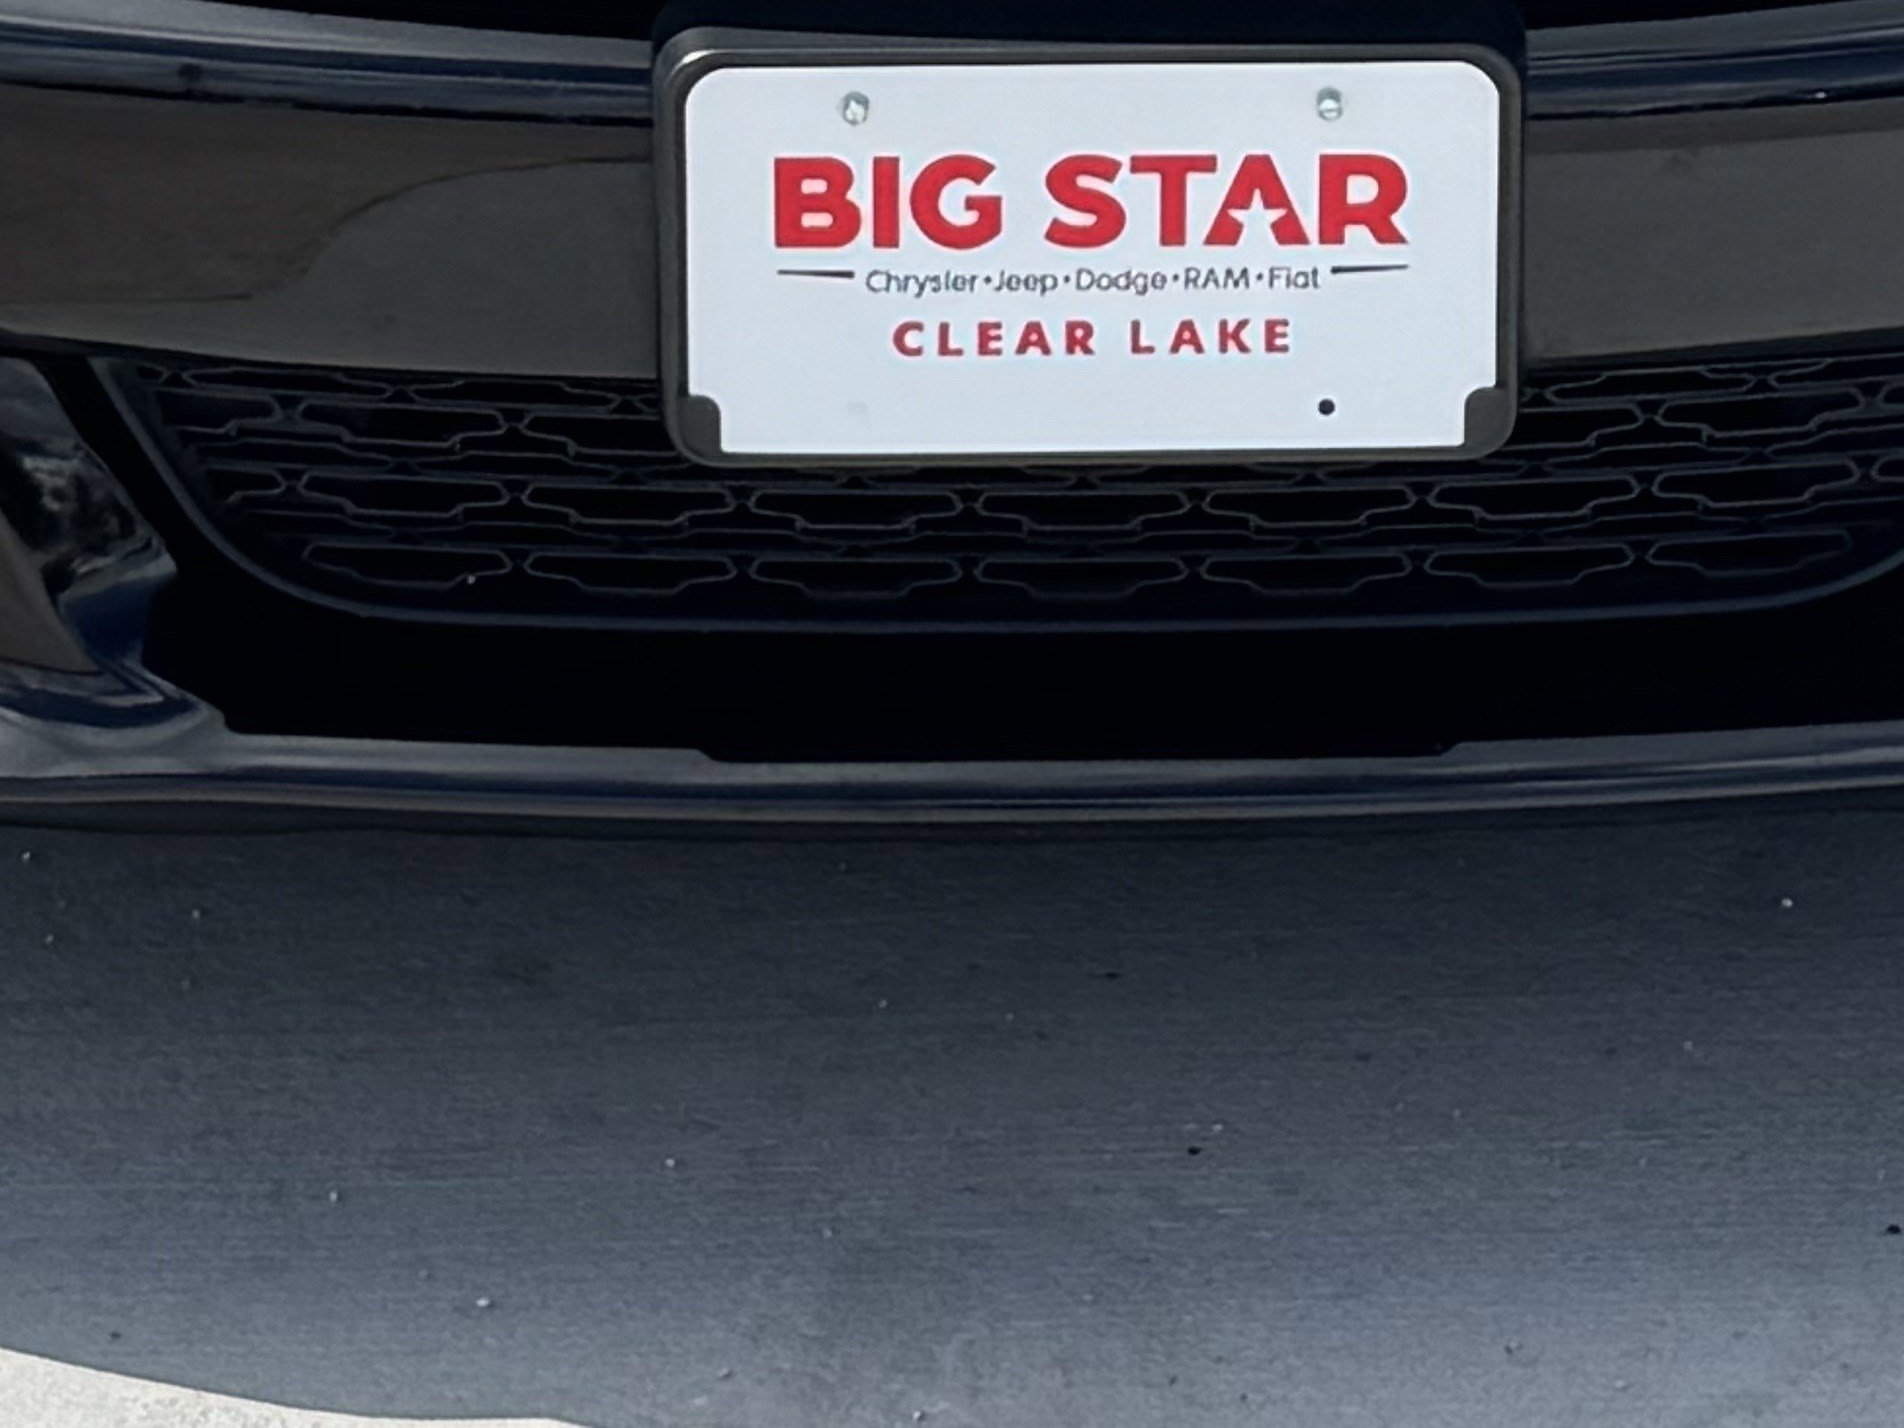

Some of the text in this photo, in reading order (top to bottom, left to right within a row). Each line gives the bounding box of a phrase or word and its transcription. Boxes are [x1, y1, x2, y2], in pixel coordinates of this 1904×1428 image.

[773, 153, 1409, 250] BIG STAR
[865, 268, 978, 299] Chrysler
[994, 269, 1058, 297] Jeep
[1075, 266, 1168, 296] Dodge
[1183, 266, 1251, 290] RAM
[892, 317, 1290, 357] CLEAR LAKE
